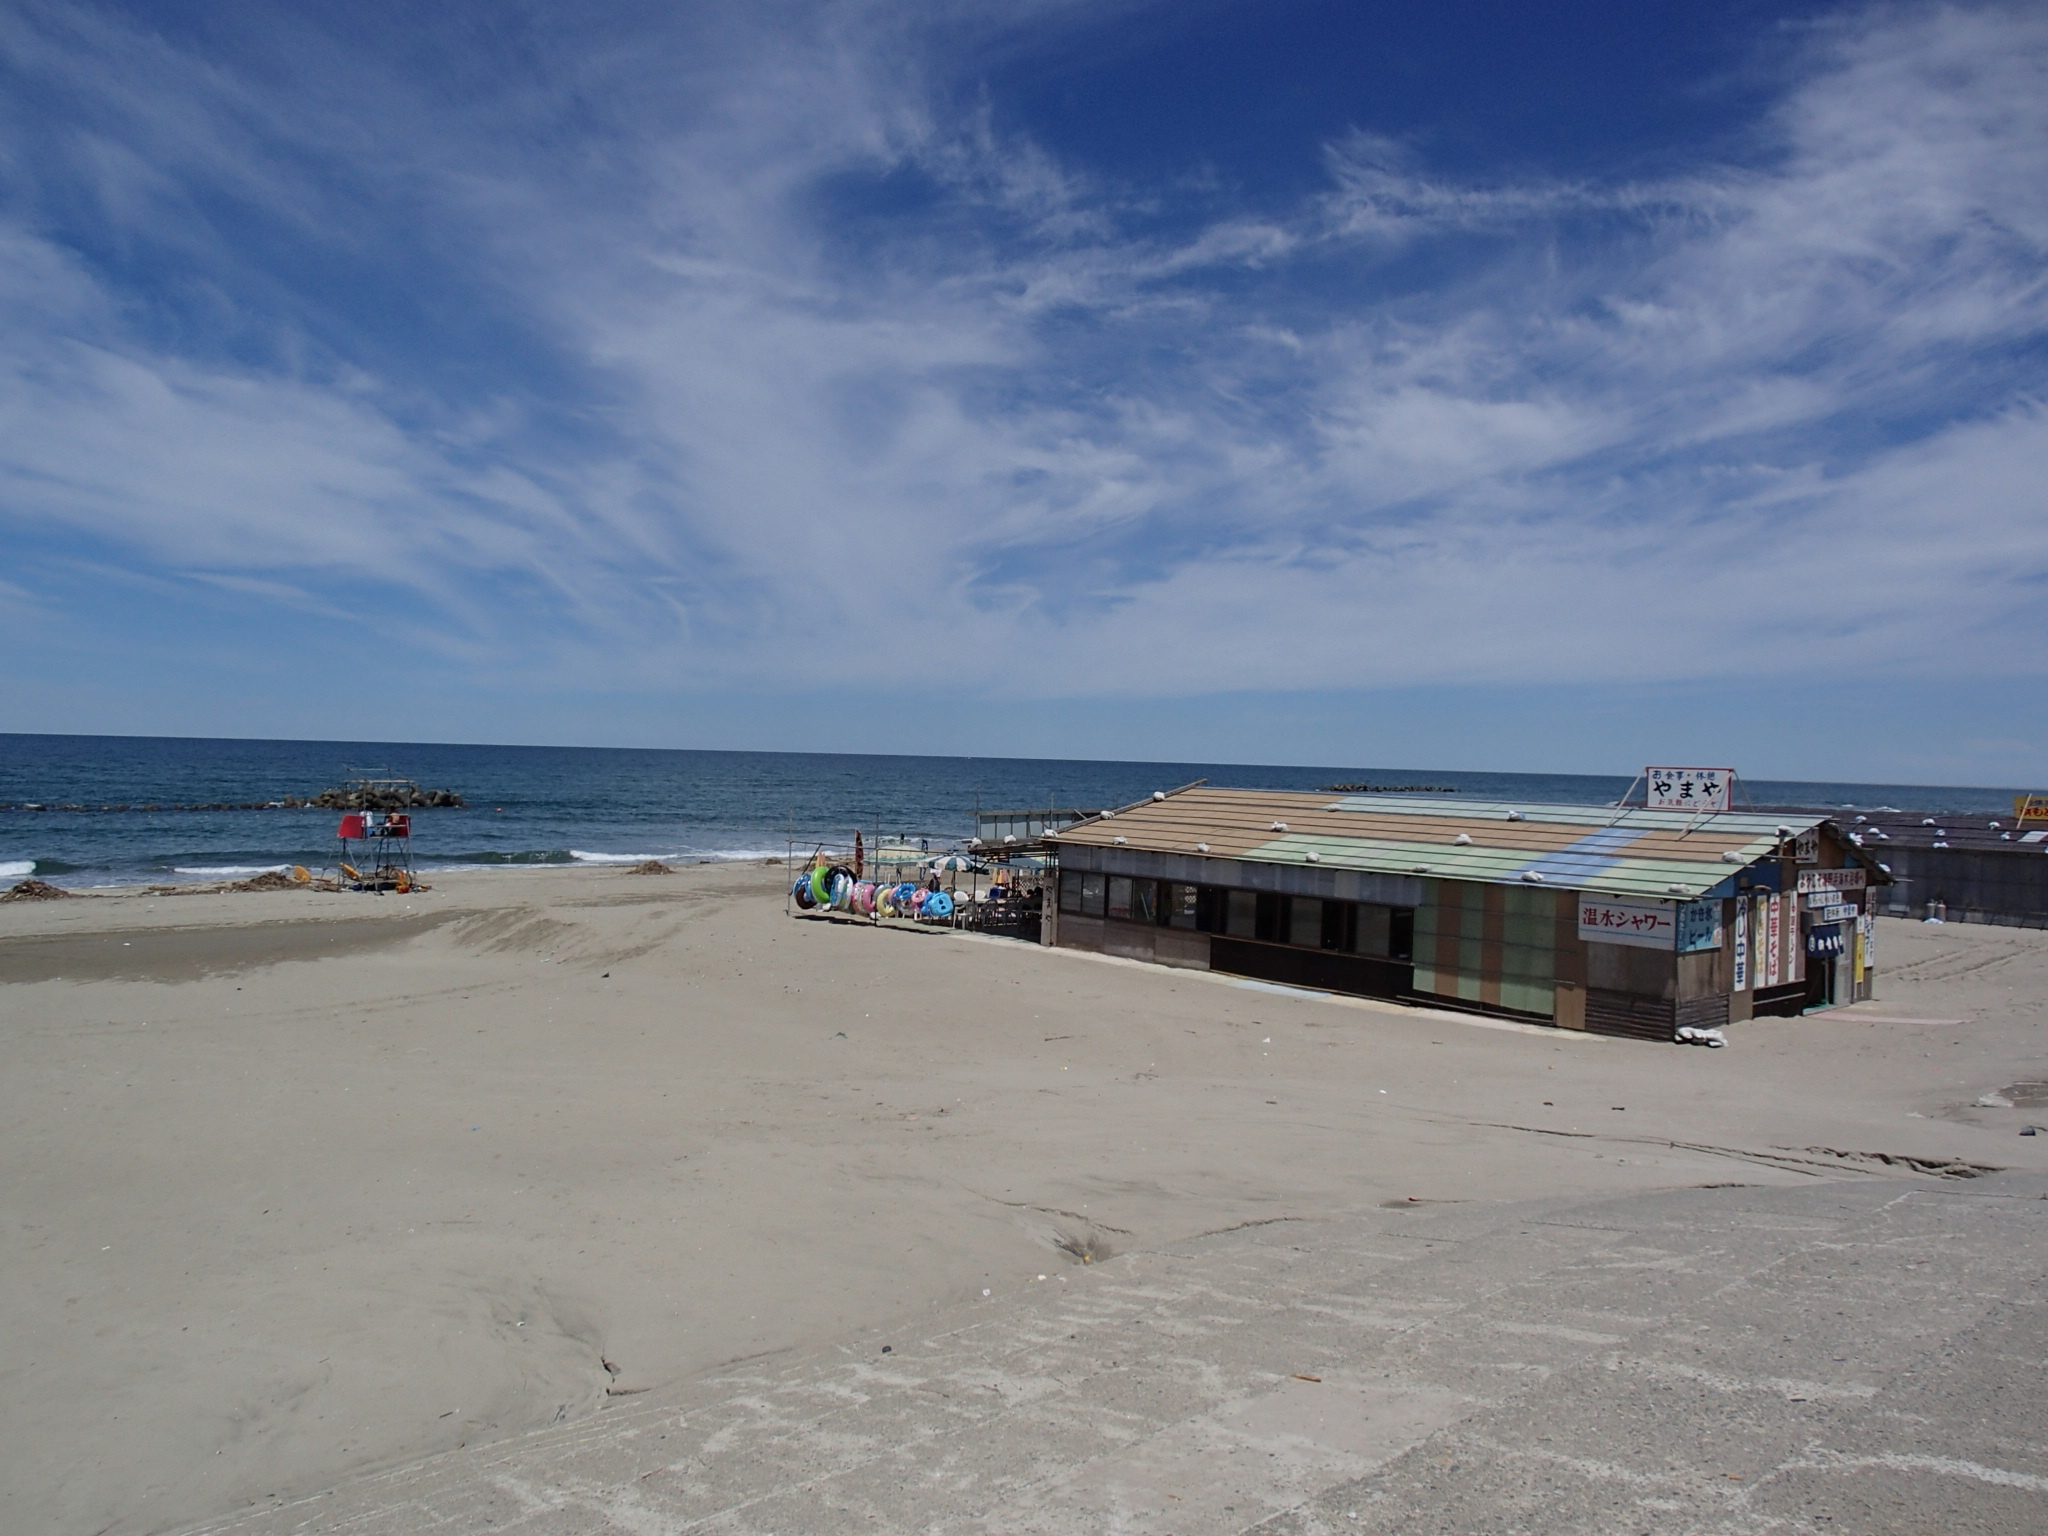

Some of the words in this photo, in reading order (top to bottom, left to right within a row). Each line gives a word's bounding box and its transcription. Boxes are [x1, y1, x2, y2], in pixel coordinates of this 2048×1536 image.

[1652, 770, 1716, 781] お食事・休憩
[1653, 781, 1722, 799] やまや
[1583, 907, 1671, 932] 温水シャワー
[1690, 904, 1713, 922] かき氷
[1690, 926, 1713, 945] ビール
[1735, 897, 1748, 984] 冷し中華
[1769, 899, 1779, 977] 中華そば
